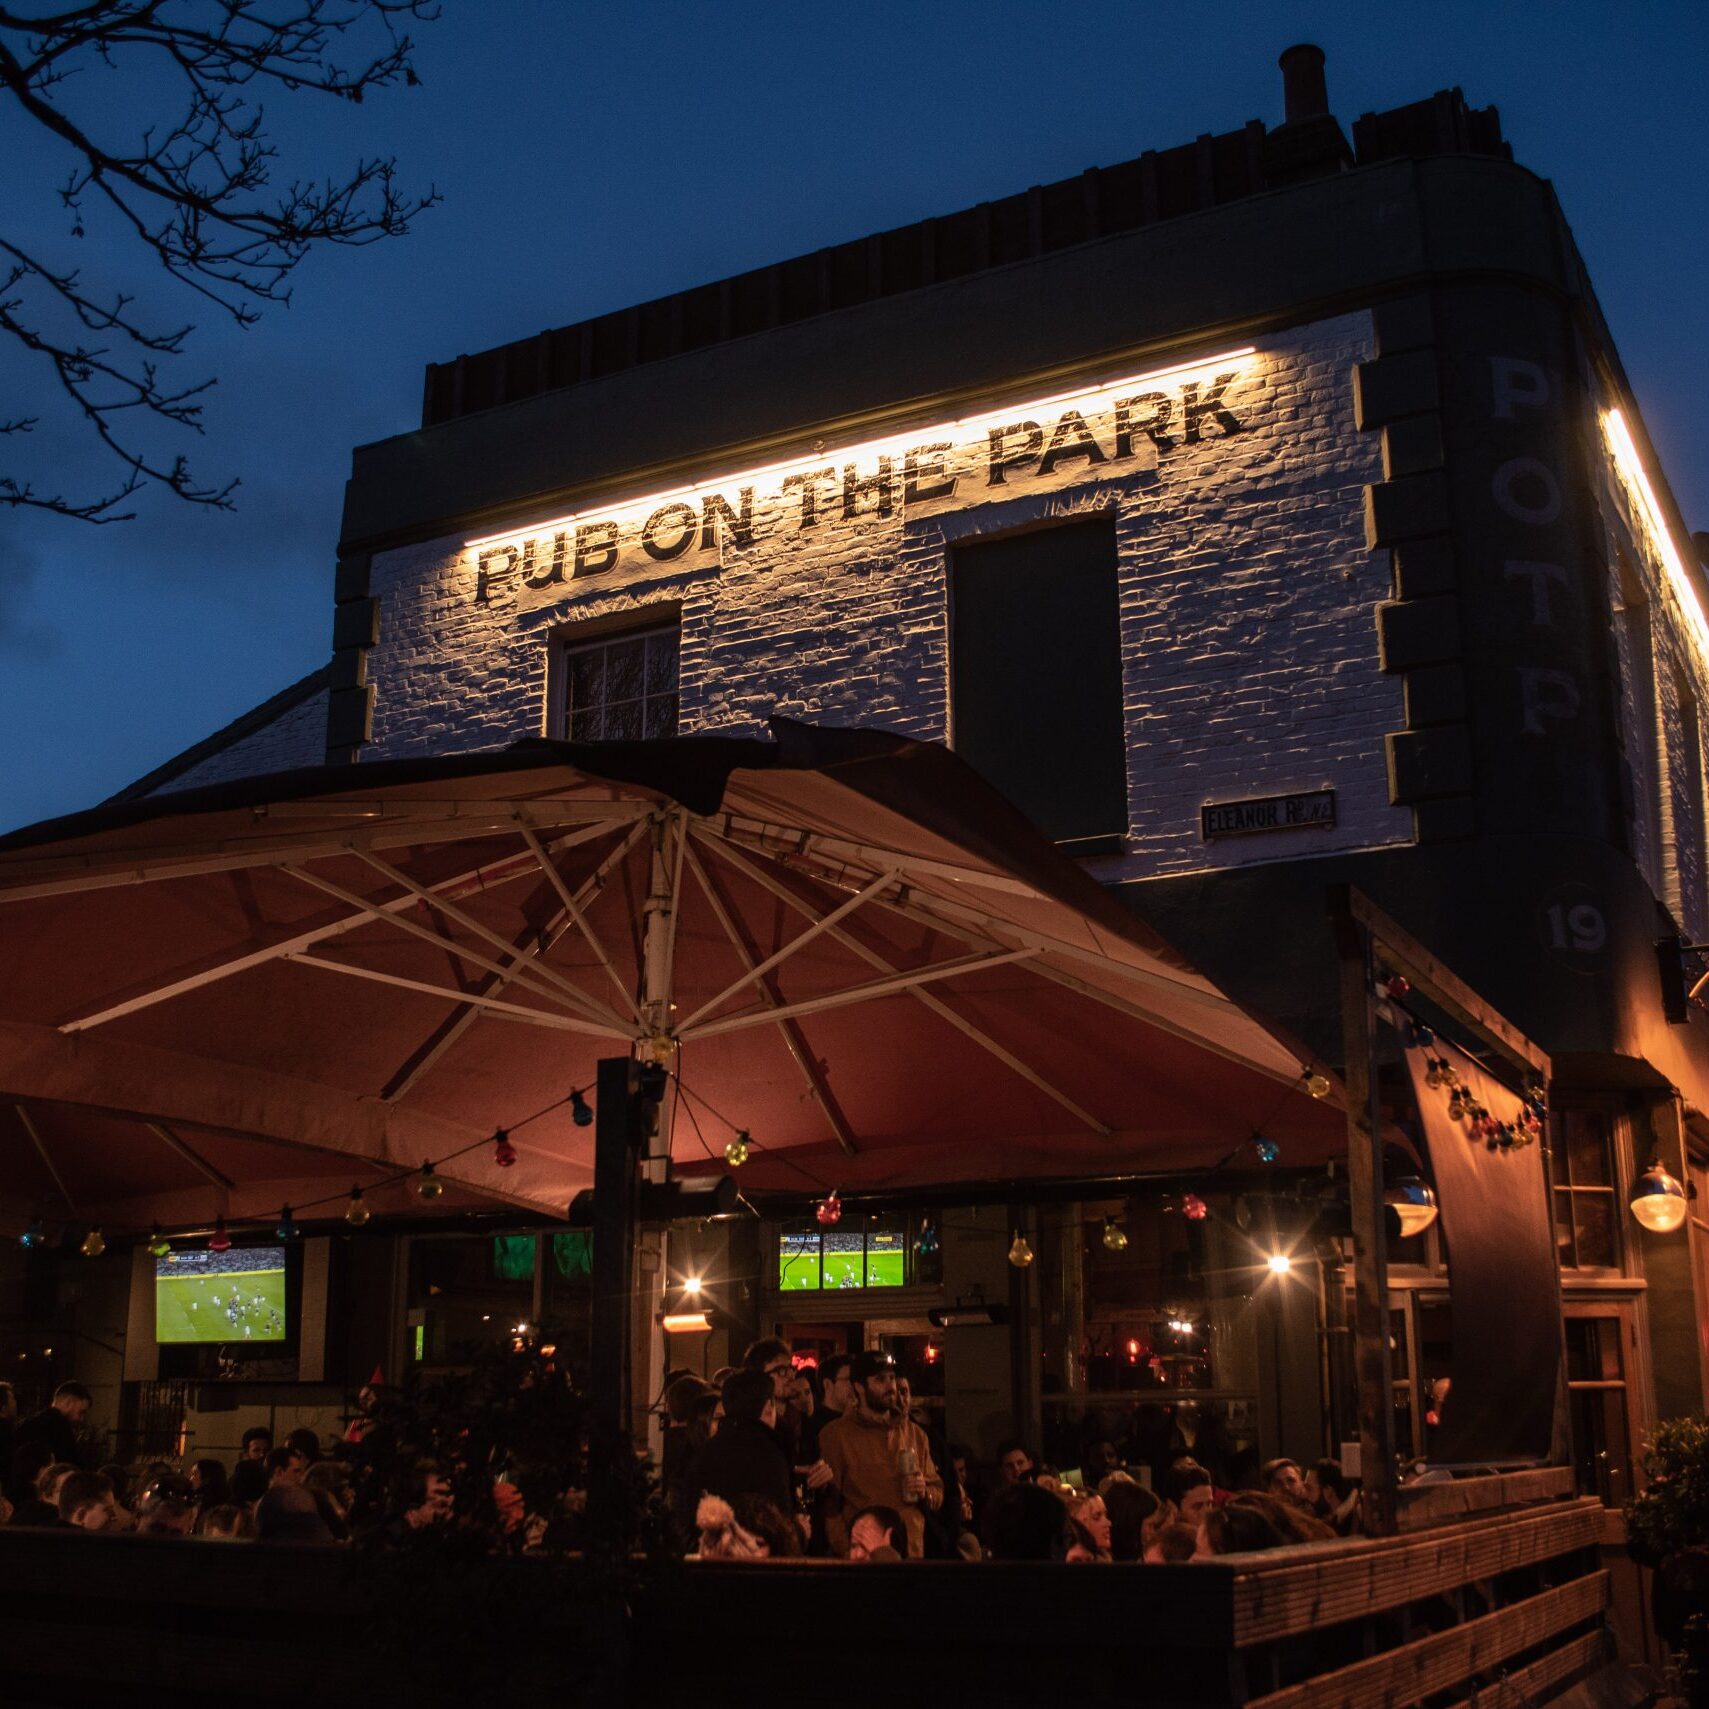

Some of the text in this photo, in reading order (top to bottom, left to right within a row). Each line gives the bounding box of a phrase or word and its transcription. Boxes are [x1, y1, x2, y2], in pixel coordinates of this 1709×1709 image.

[477, 374, 1245, 600] PUB ON THE PARK
[1209, 804, 1277, 833] ELEANOR
[1546, 904, 1606, 950] 19
